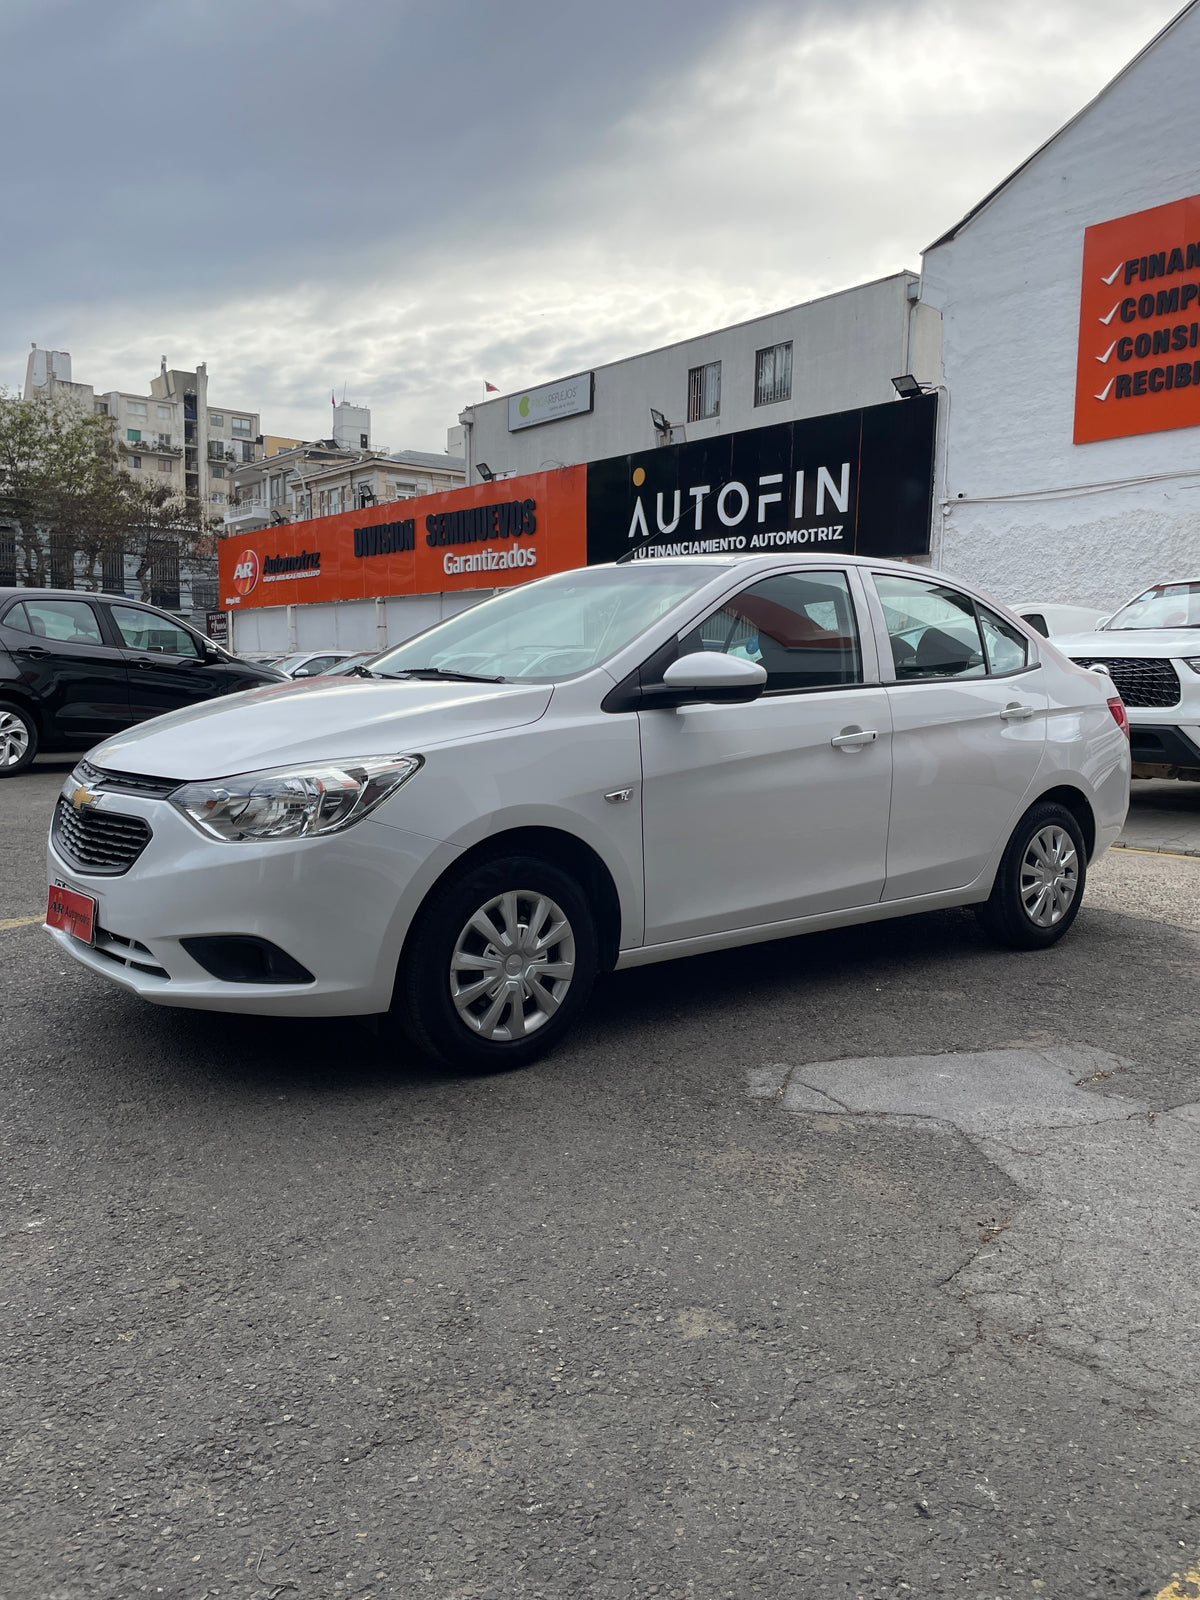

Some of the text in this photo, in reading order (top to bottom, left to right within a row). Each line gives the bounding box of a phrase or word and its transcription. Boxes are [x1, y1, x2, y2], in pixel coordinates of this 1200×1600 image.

[1120, 282, 1200, 323] COMP
[627, 462, 850, 538] AUTOFIN
[353, 498, 537, 557] DIVISION SEMINUEVOS
[648, 535, 747, 559] FINANCIAMIENTO
[750, 525, 844, 549] AUTOMOTRIZ
[262, 549, 321, 575] Automotriz
[443, 543, 537, 575] Garantizados
